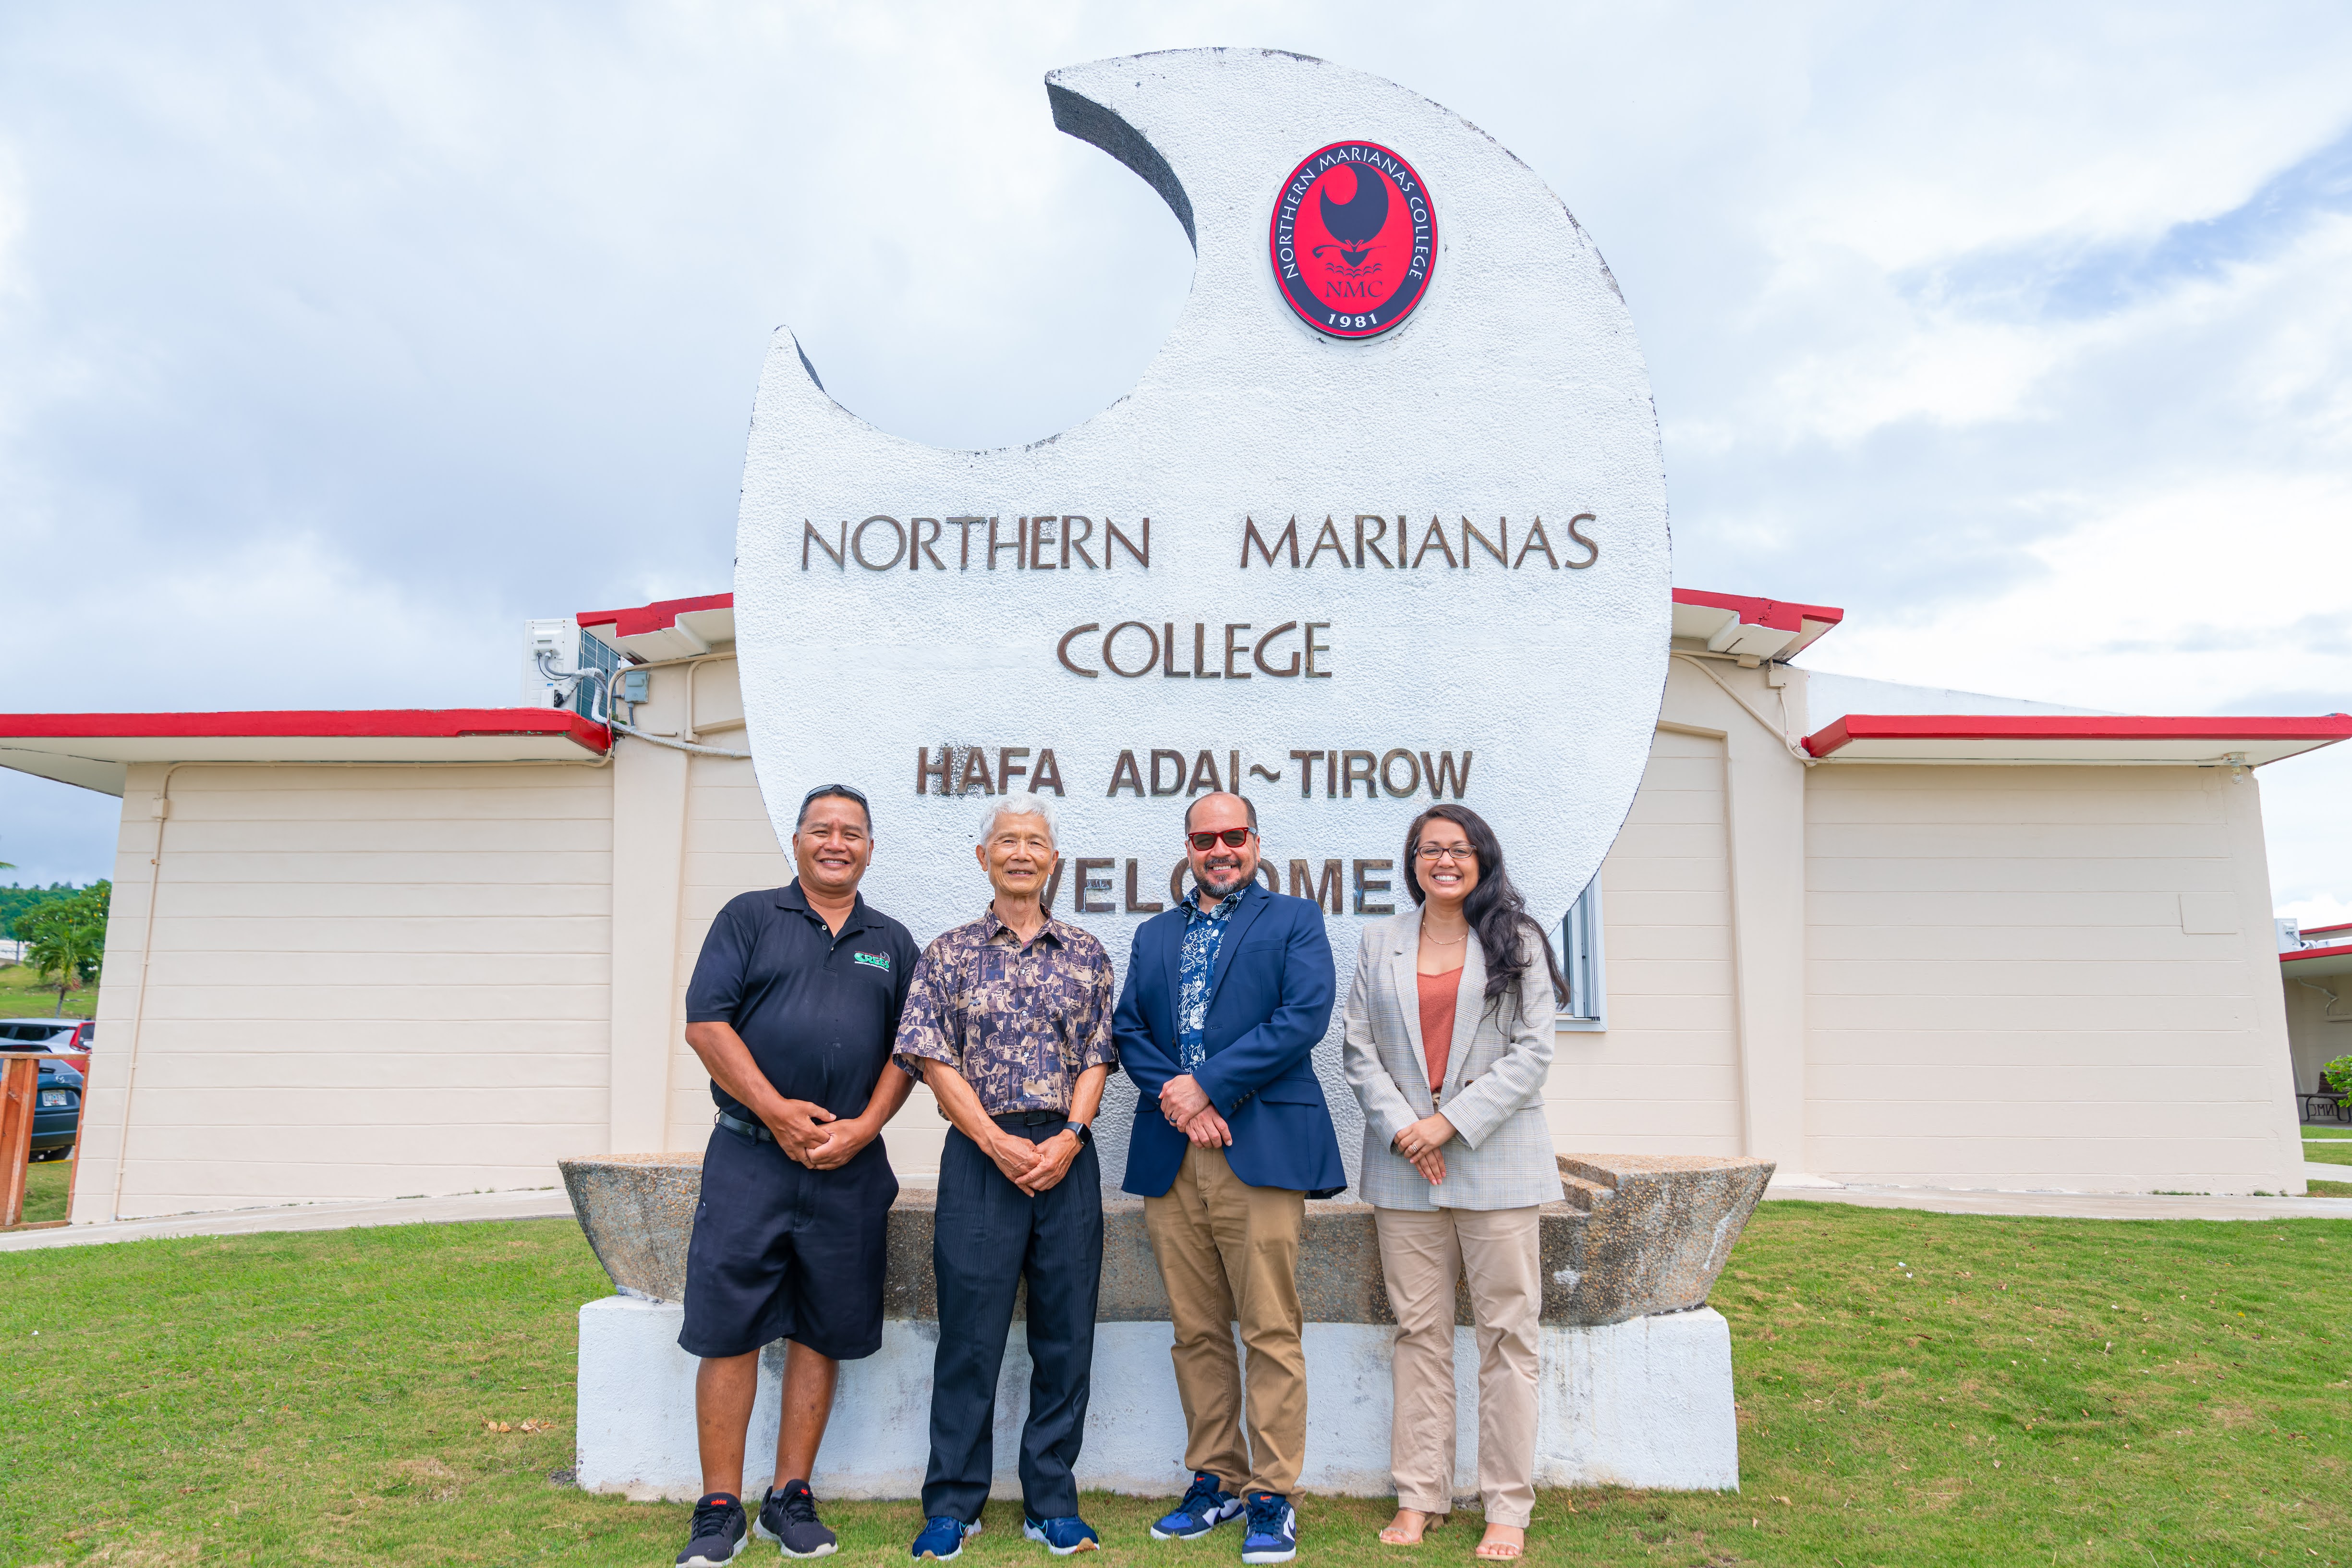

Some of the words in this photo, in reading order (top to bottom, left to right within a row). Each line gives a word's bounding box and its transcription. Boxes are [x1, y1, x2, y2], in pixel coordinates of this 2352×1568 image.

[1279, 168, 1316, 279] NORTHERN
[1319, 147, 1414, 192] MARIANAS
[1408, 197, 1429, 280] COLLEGE
[1325, 281, 1382, 298] NMC
[1328, 313, 1377, 328] 1981
[801, 515, 1150, 571] NORTHERN
[1240, 513, 1599, 570] MARIANAS
[1056, 620, 1332, 678] COLLEGE
[917, 747, 1065, 797] HAFA
[854, 952, 889, 969] CREES
